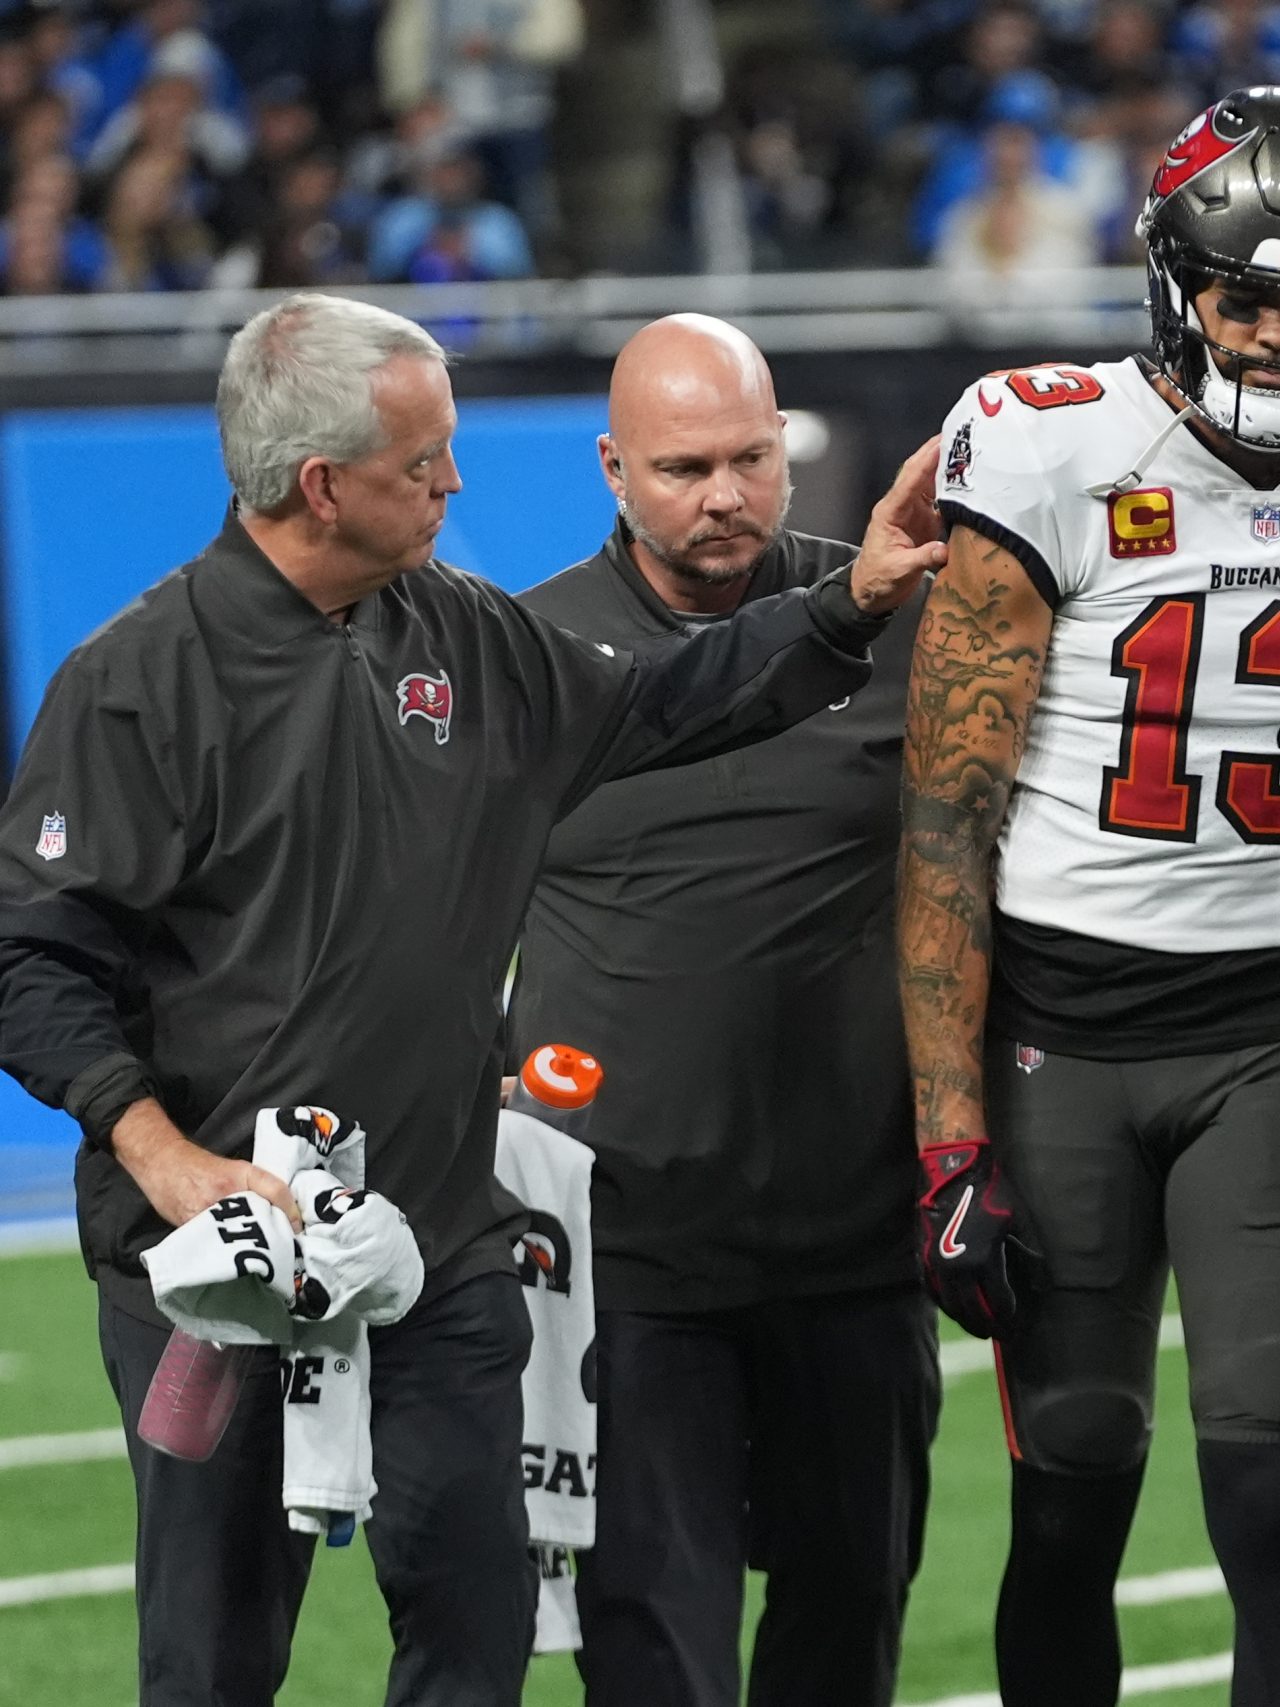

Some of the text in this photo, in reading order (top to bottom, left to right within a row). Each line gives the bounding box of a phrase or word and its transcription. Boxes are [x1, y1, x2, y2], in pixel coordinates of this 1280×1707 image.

[1113, 492, 1170, 539] C
[1256, 520, 1278, 538] NFL
[41, 834, 63, 853] NFL
